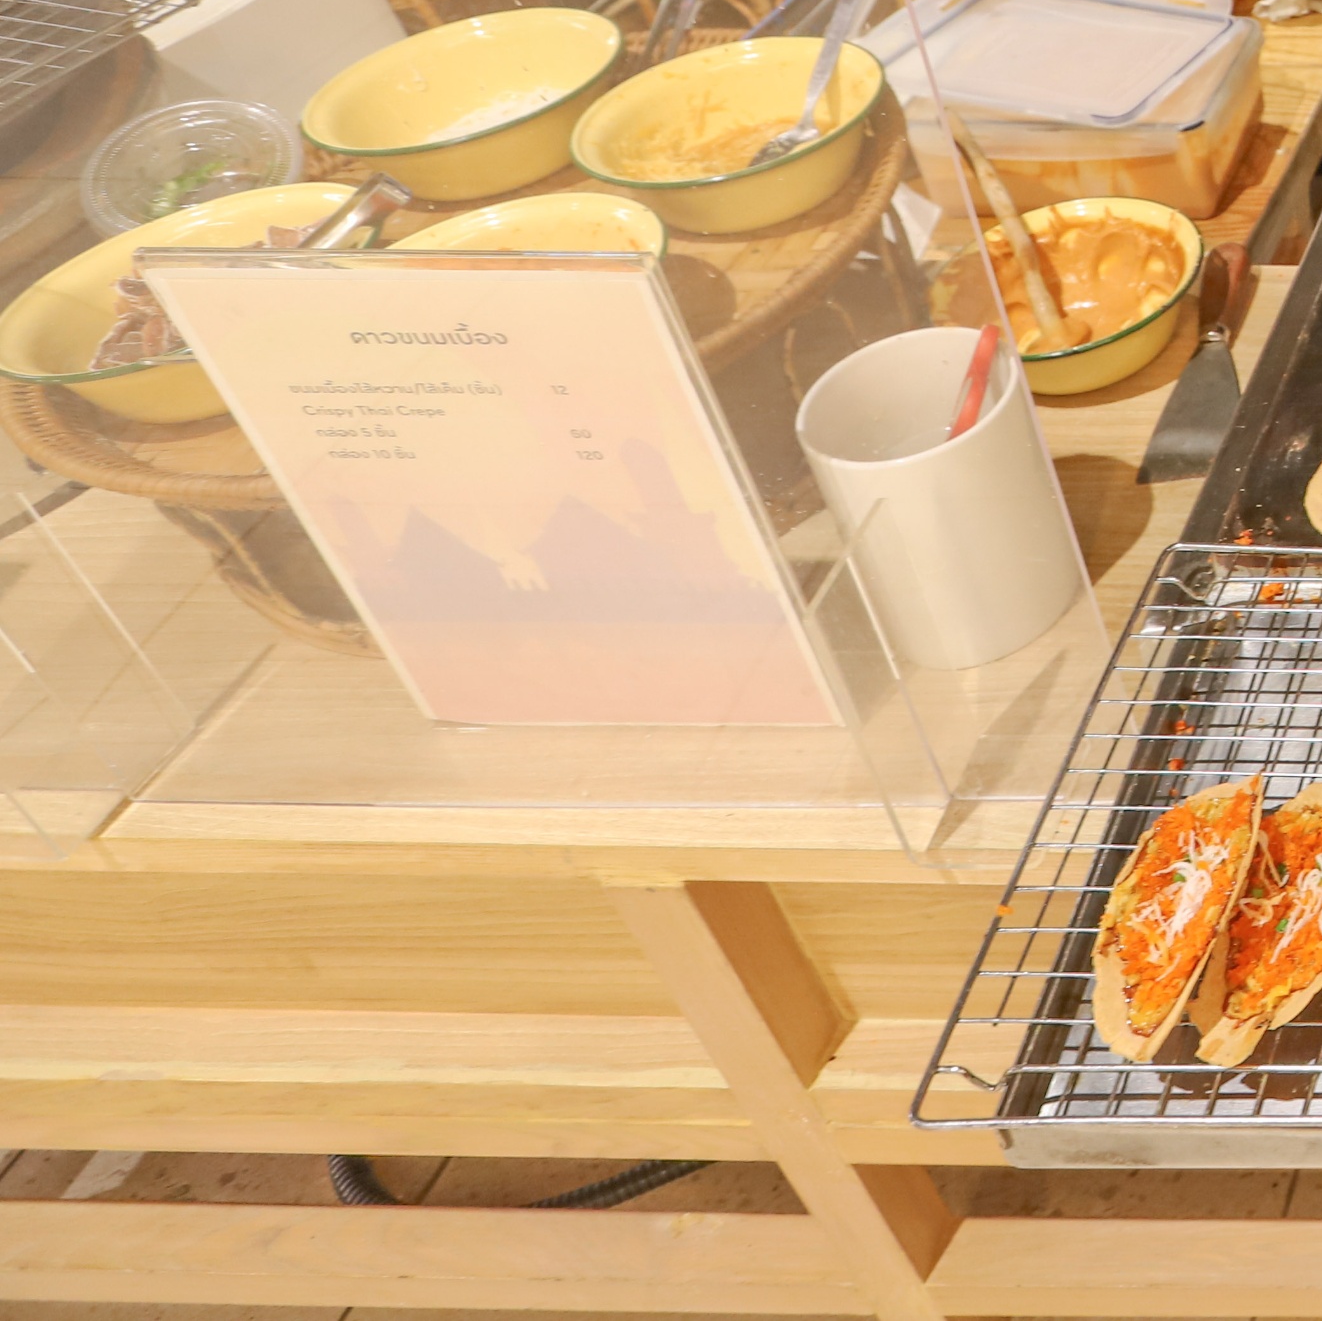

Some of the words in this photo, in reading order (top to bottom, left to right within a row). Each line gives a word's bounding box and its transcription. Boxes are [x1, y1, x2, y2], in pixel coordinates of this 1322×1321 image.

[550, 384, 569, 395] 12
[302, 405, 354, 418] Crispy
[354, 405, 394, 416] Thai
[396, 405, 446, 418] Crepe
[372, 450, 391, 459] 10
[575, 450, 604, 460] 120
